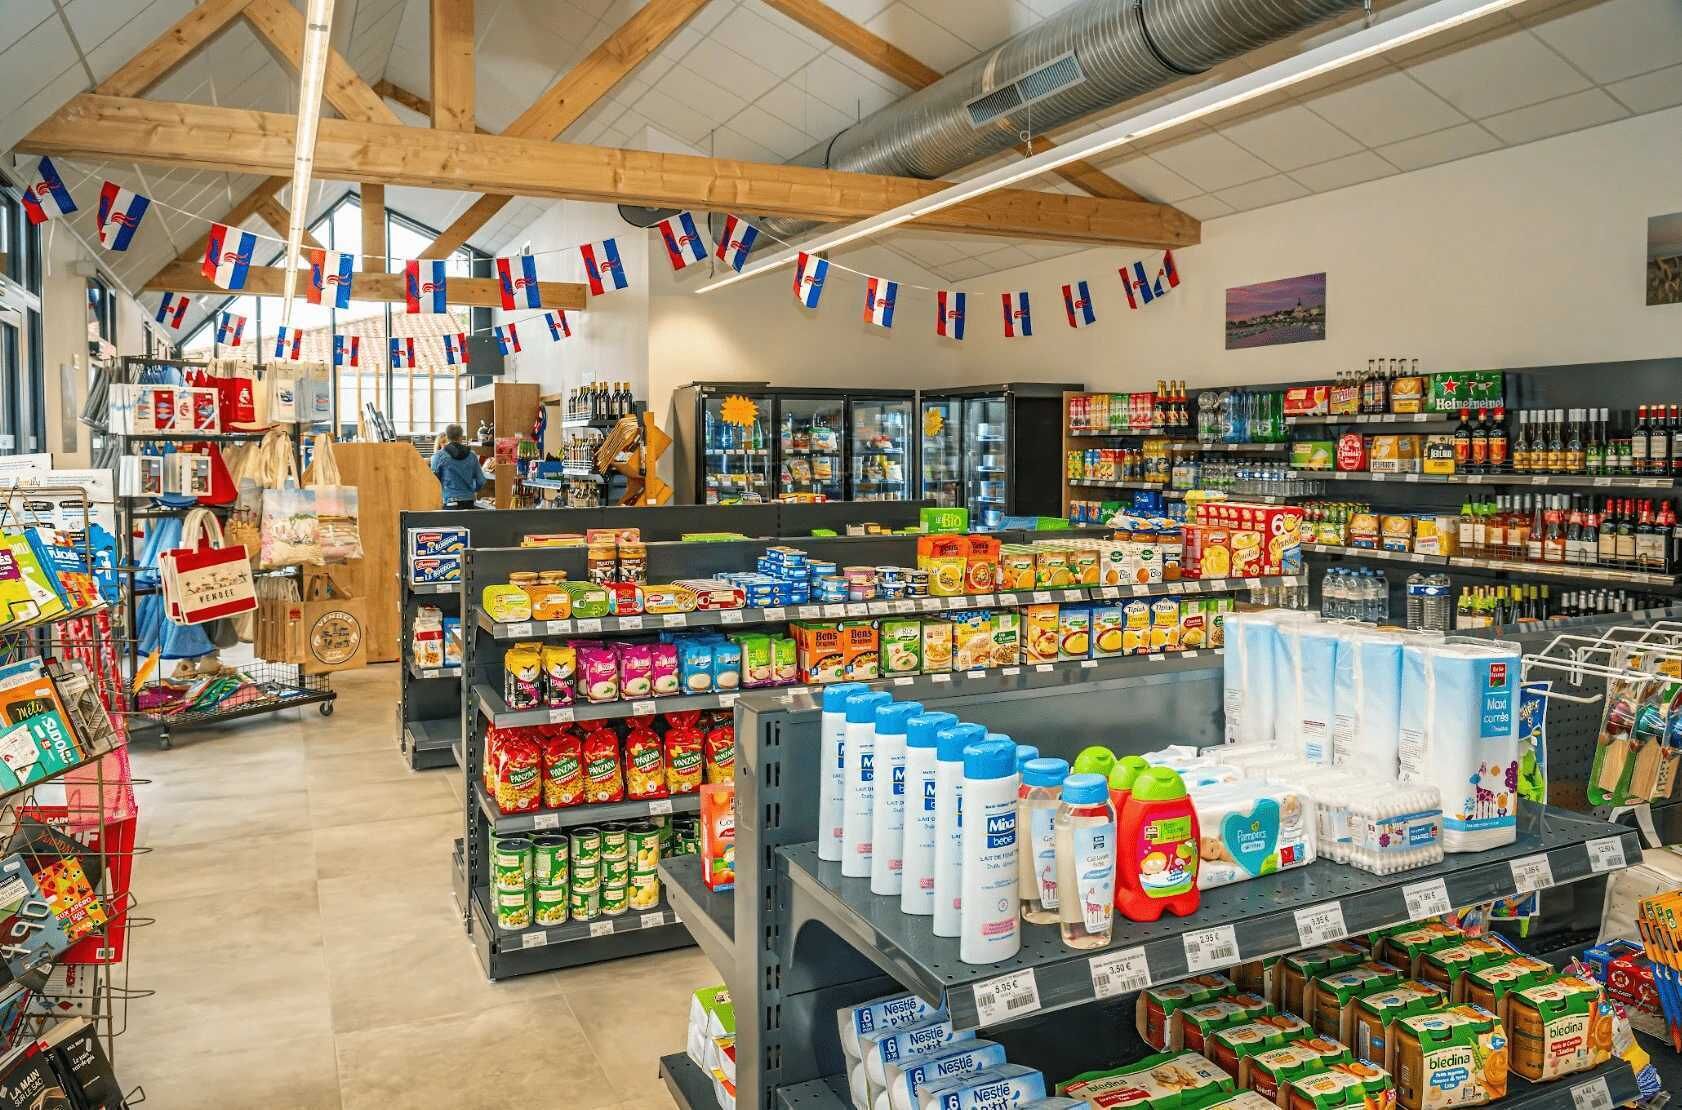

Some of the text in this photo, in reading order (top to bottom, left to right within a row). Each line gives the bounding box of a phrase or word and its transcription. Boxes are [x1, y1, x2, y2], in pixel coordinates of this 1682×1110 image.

[1487, 697, 1507, 710] Maxi
[1011, 980, 1018, 989] €
[862, 1009, 872, 1022] 6
[887, 1039, 897, 1053] 6
[914, 1070, 924, 1083] 6
[950, 1095, 958, 1109] 6
